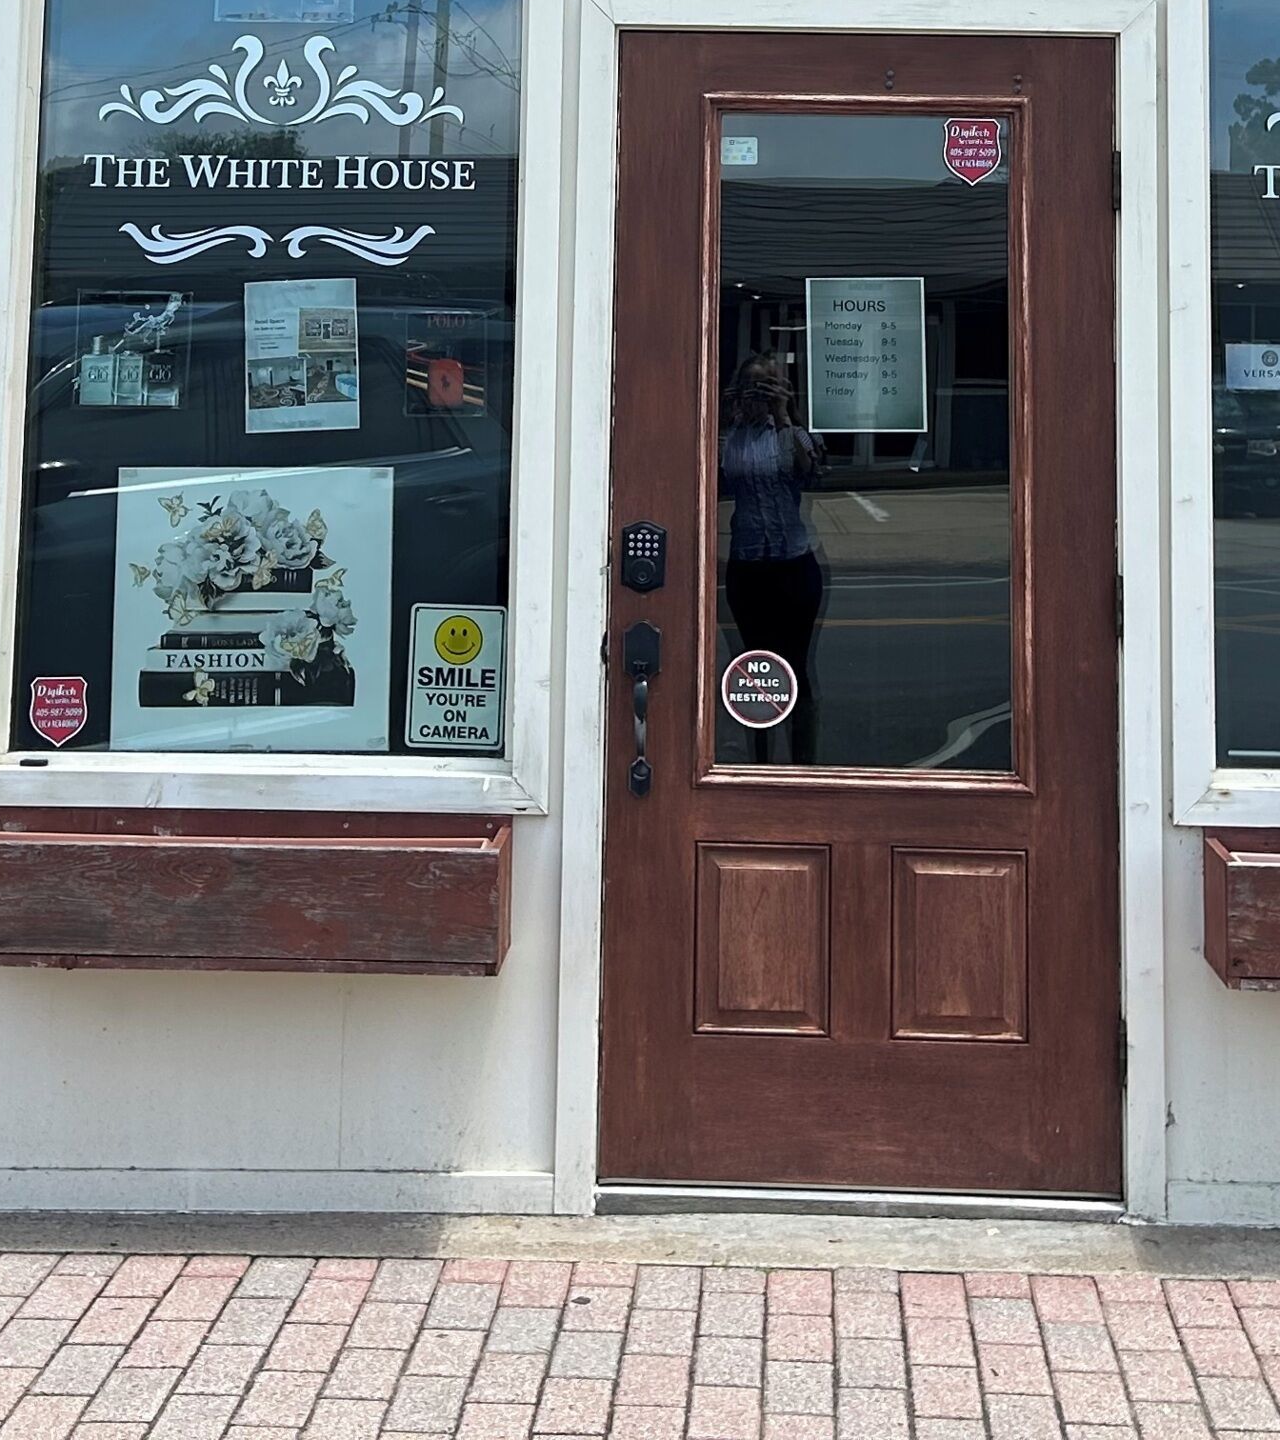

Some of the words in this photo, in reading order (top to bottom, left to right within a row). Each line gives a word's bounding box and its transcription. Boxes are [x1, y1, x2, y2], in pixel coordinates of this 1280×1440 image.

[83, 154, 170, 188] THE
[179, 154, 323, 189] WHITE
[334, 155, 476, 191] HOUSE
[833, 299, 886, 312] HOURS
[427, 315, 465, 329] POLO
[824, 321, 862, 332] Monday
[880, 322, 896, 330] 9-5
[824, 337, 864, 348] Tuesday
[881, 338, 897, 346] 9-5
[824, 354, 880, 364] Wednesday
[881, 354, 897, 363] 9-5
[825, 370, 868, 381] Thursday
[881, 370, 897, 378] 9-5
[825, 386, 855, 397] Friday
[882, 387, 898, 395] 9-5
[166, 653, 265, 668] FASHION
[747, 661, 771, 673] NO
[417, 666, 496, 688] SMILE
[738, 678, 780, 687] PUBLIC
[425, 693, 486, 707] YOU'RE
[729, 693, 789, 702] RESTROOM
[443, 709, 467, 723] ON
[419, 724, 490, 740] CAMERA
